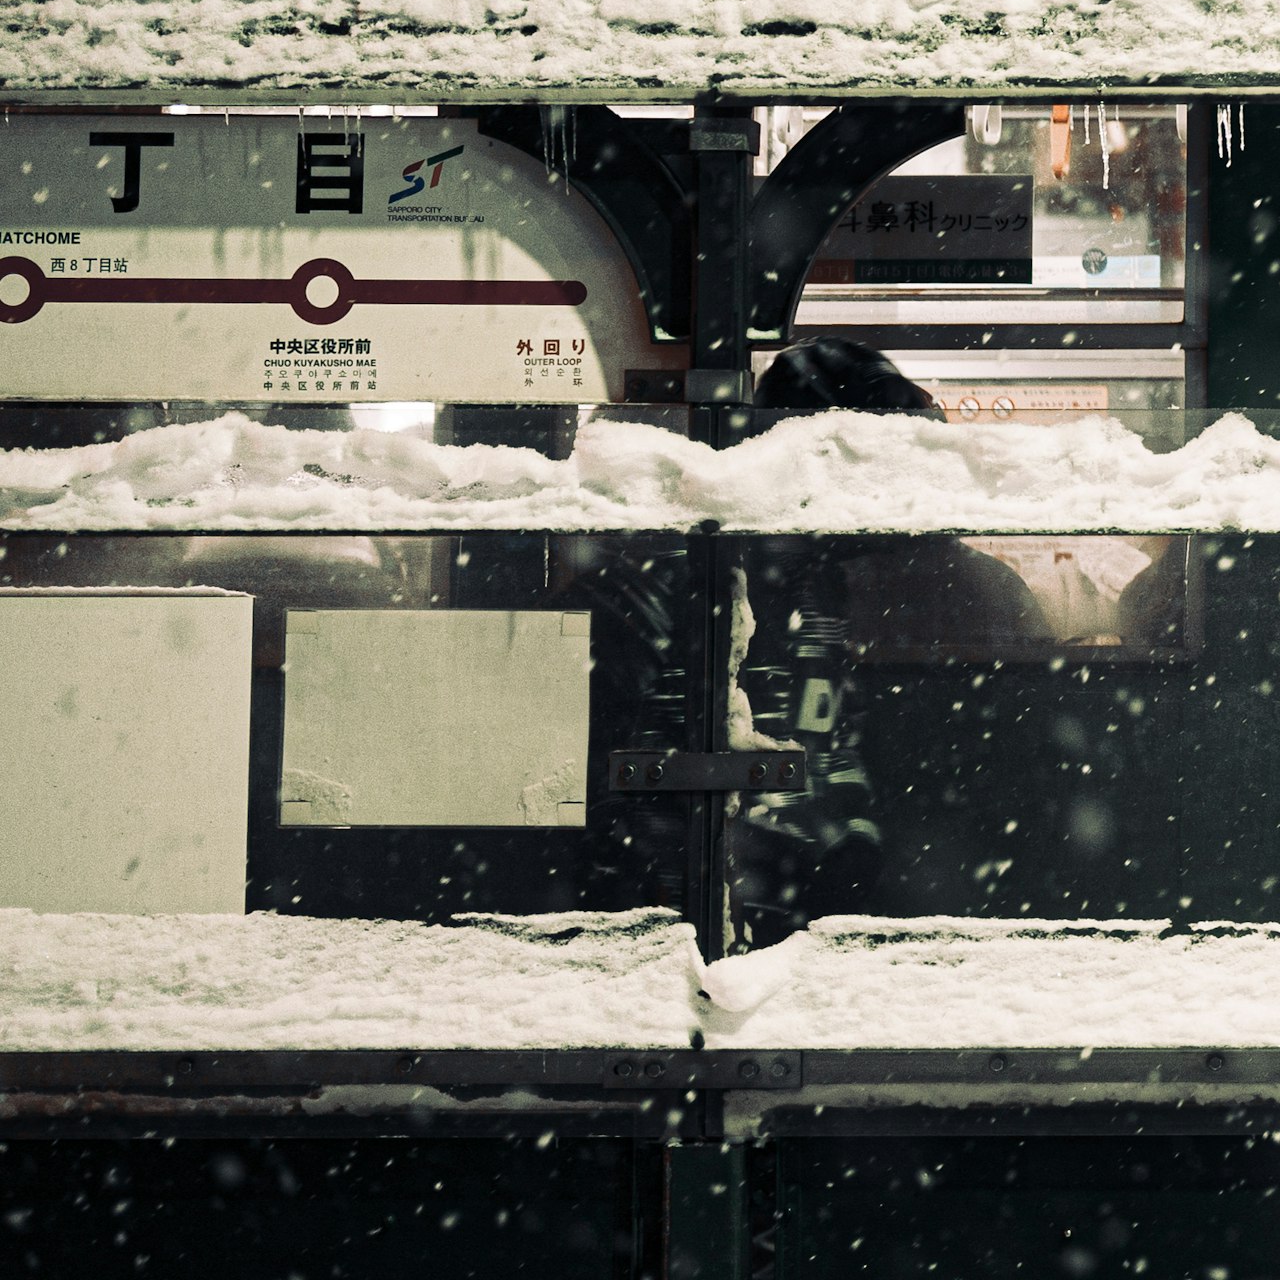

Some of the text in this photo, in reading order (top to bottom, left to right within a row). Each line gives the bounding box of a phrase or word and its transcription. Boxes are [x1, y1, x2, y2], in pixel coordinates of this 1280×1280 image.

[89, 132, 365, 214] 丁目
[270, 338, 371, 354] 中央区役所前
[516, 339, 585, 356] 外回り
[264, 359, 377, 367] CHUO KUYAKUSHO MAE
[524, 358, 582, 366] OUTER LOOP
[263, 381, 377, 391] 中央区役所前站
